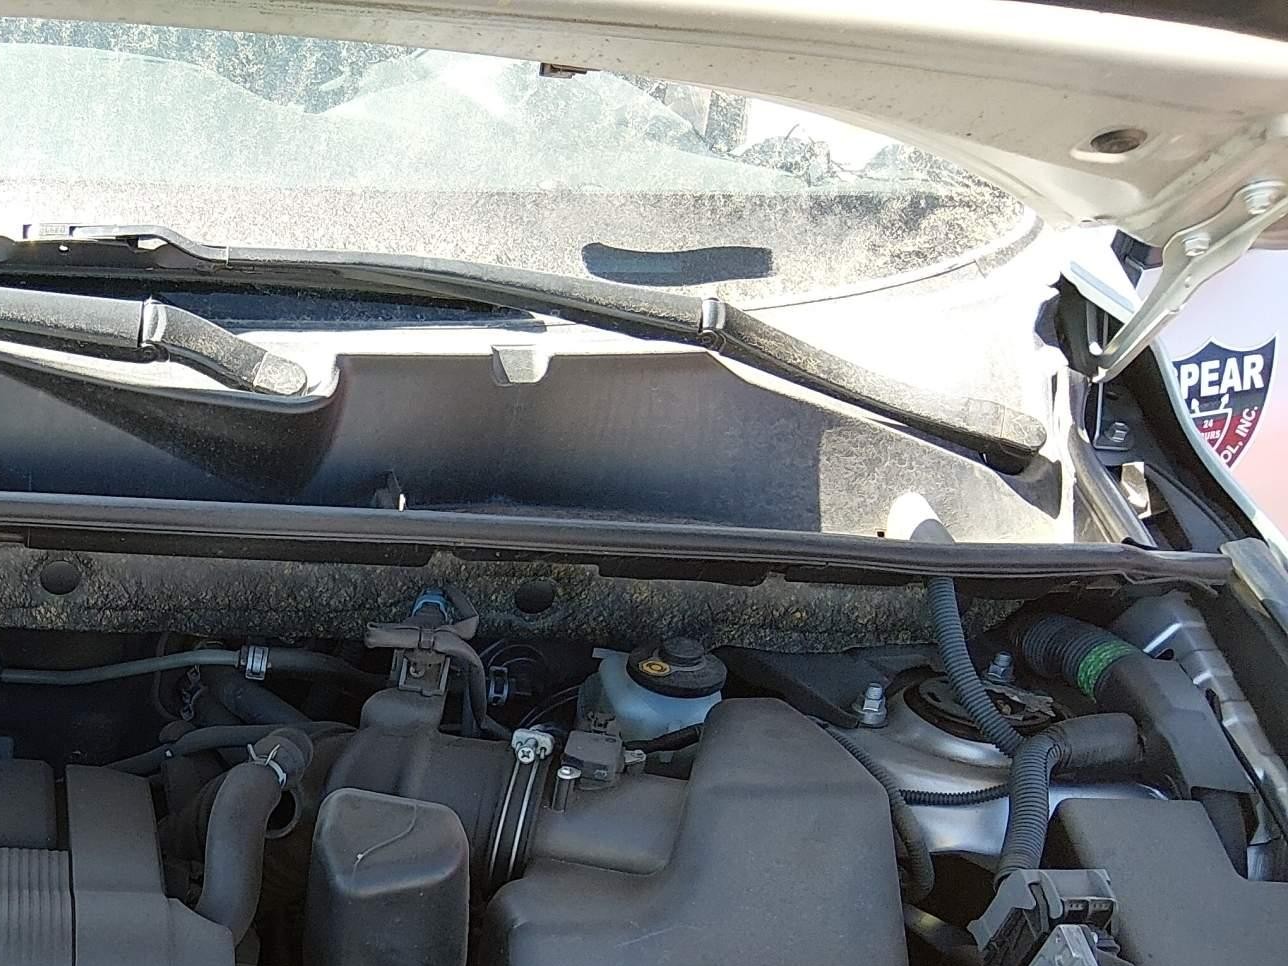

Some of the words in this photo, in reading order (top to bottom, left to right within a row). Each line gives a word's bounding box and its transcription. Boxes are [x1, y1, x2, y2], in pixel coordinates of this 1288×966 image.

[1173, 354, 1265, 400] PEAR
[1202, 419, 1214, 429] 24
[1236, 406, 1260, 438] INC.
